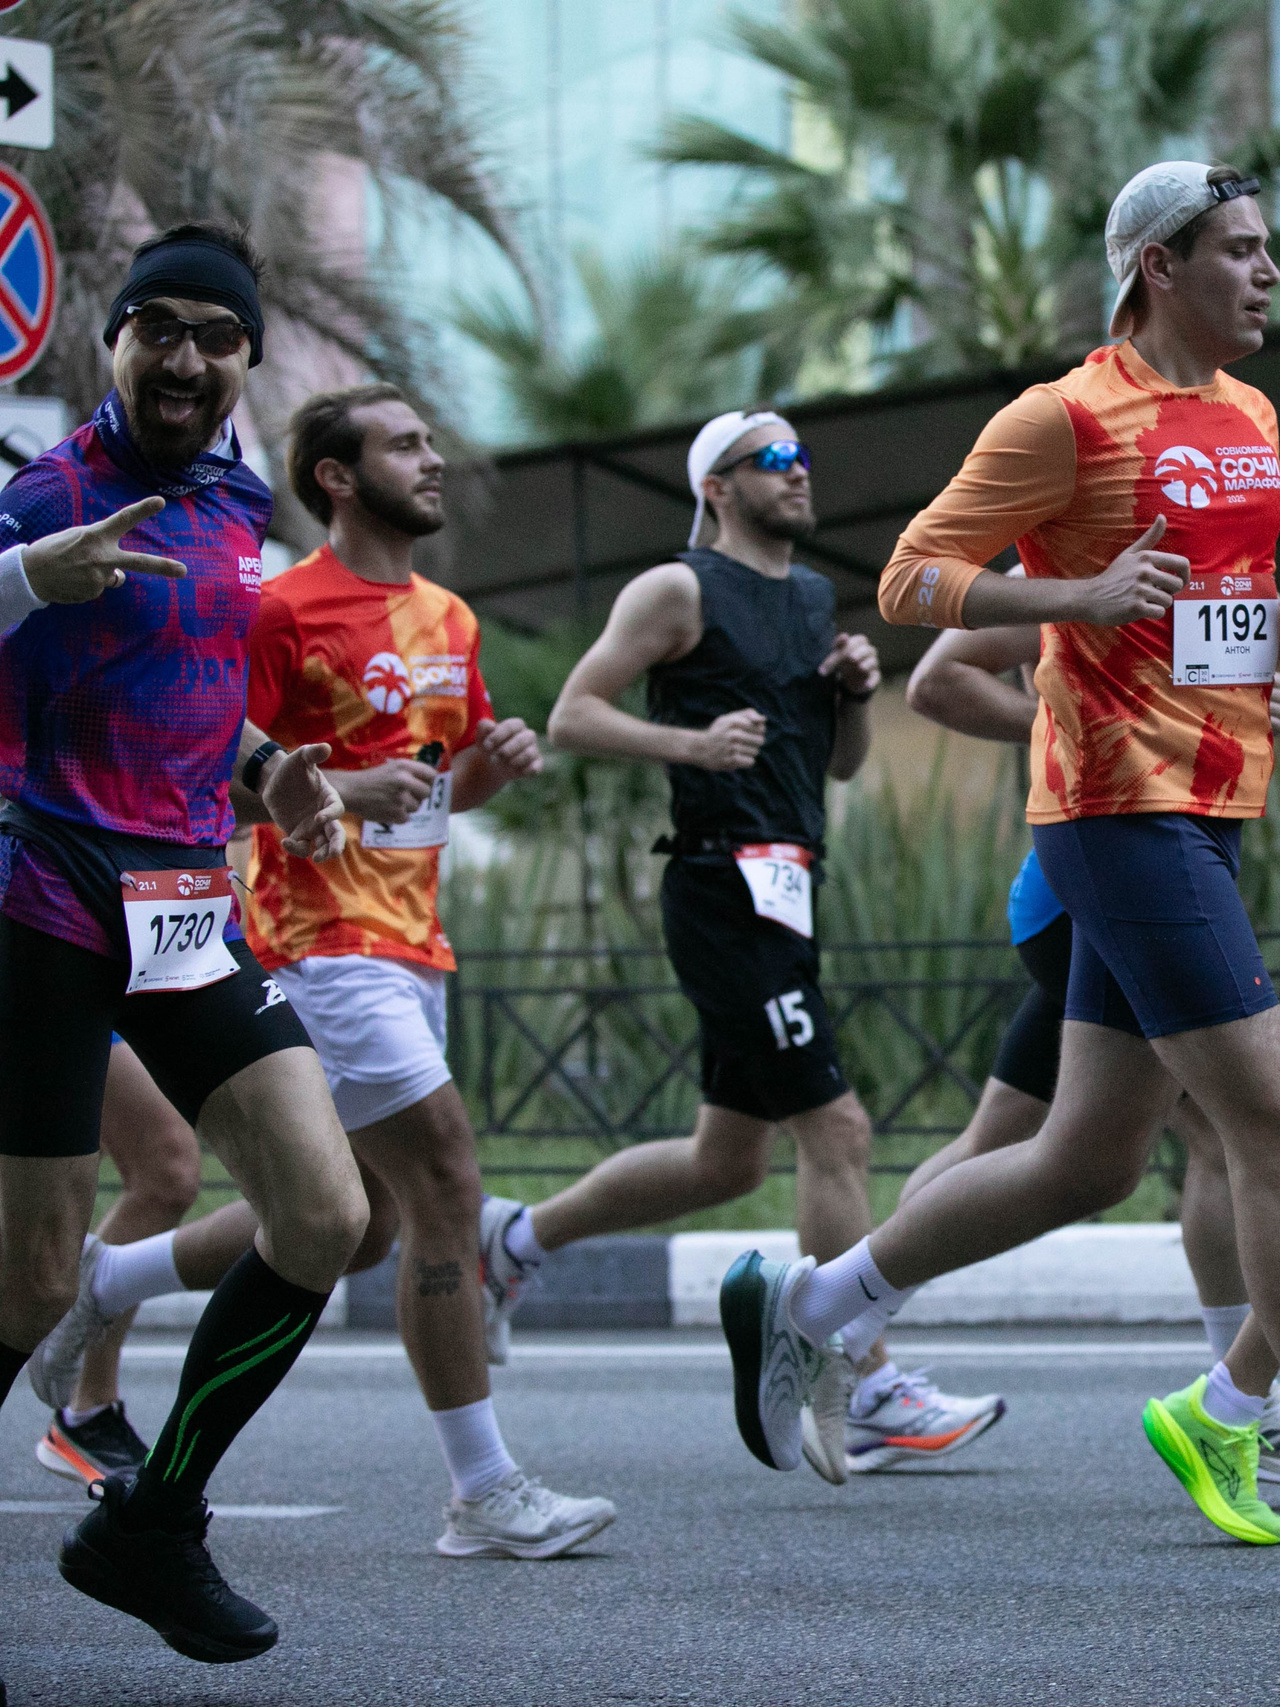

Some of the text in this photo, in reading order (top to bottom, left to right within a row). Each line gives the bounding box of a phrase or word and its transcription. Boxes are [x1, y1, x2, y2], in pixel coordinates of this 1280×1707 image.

[1215, 446, 1274, 455] СОВКОМБАНК
[1220, 457, 1280, 478] СОЧИ
[1226, 495, 1246, 503] 2025
[1189, 582, 1205, 591] 21.1
[1198, 604, 1267, 641] 1192
[1225, 646, 1250, 654] АНТОН
[138, 881, 157, 891] 21.1
[150, 910, 215, 956] 1730
[763, 989, 815, 1051] 15
